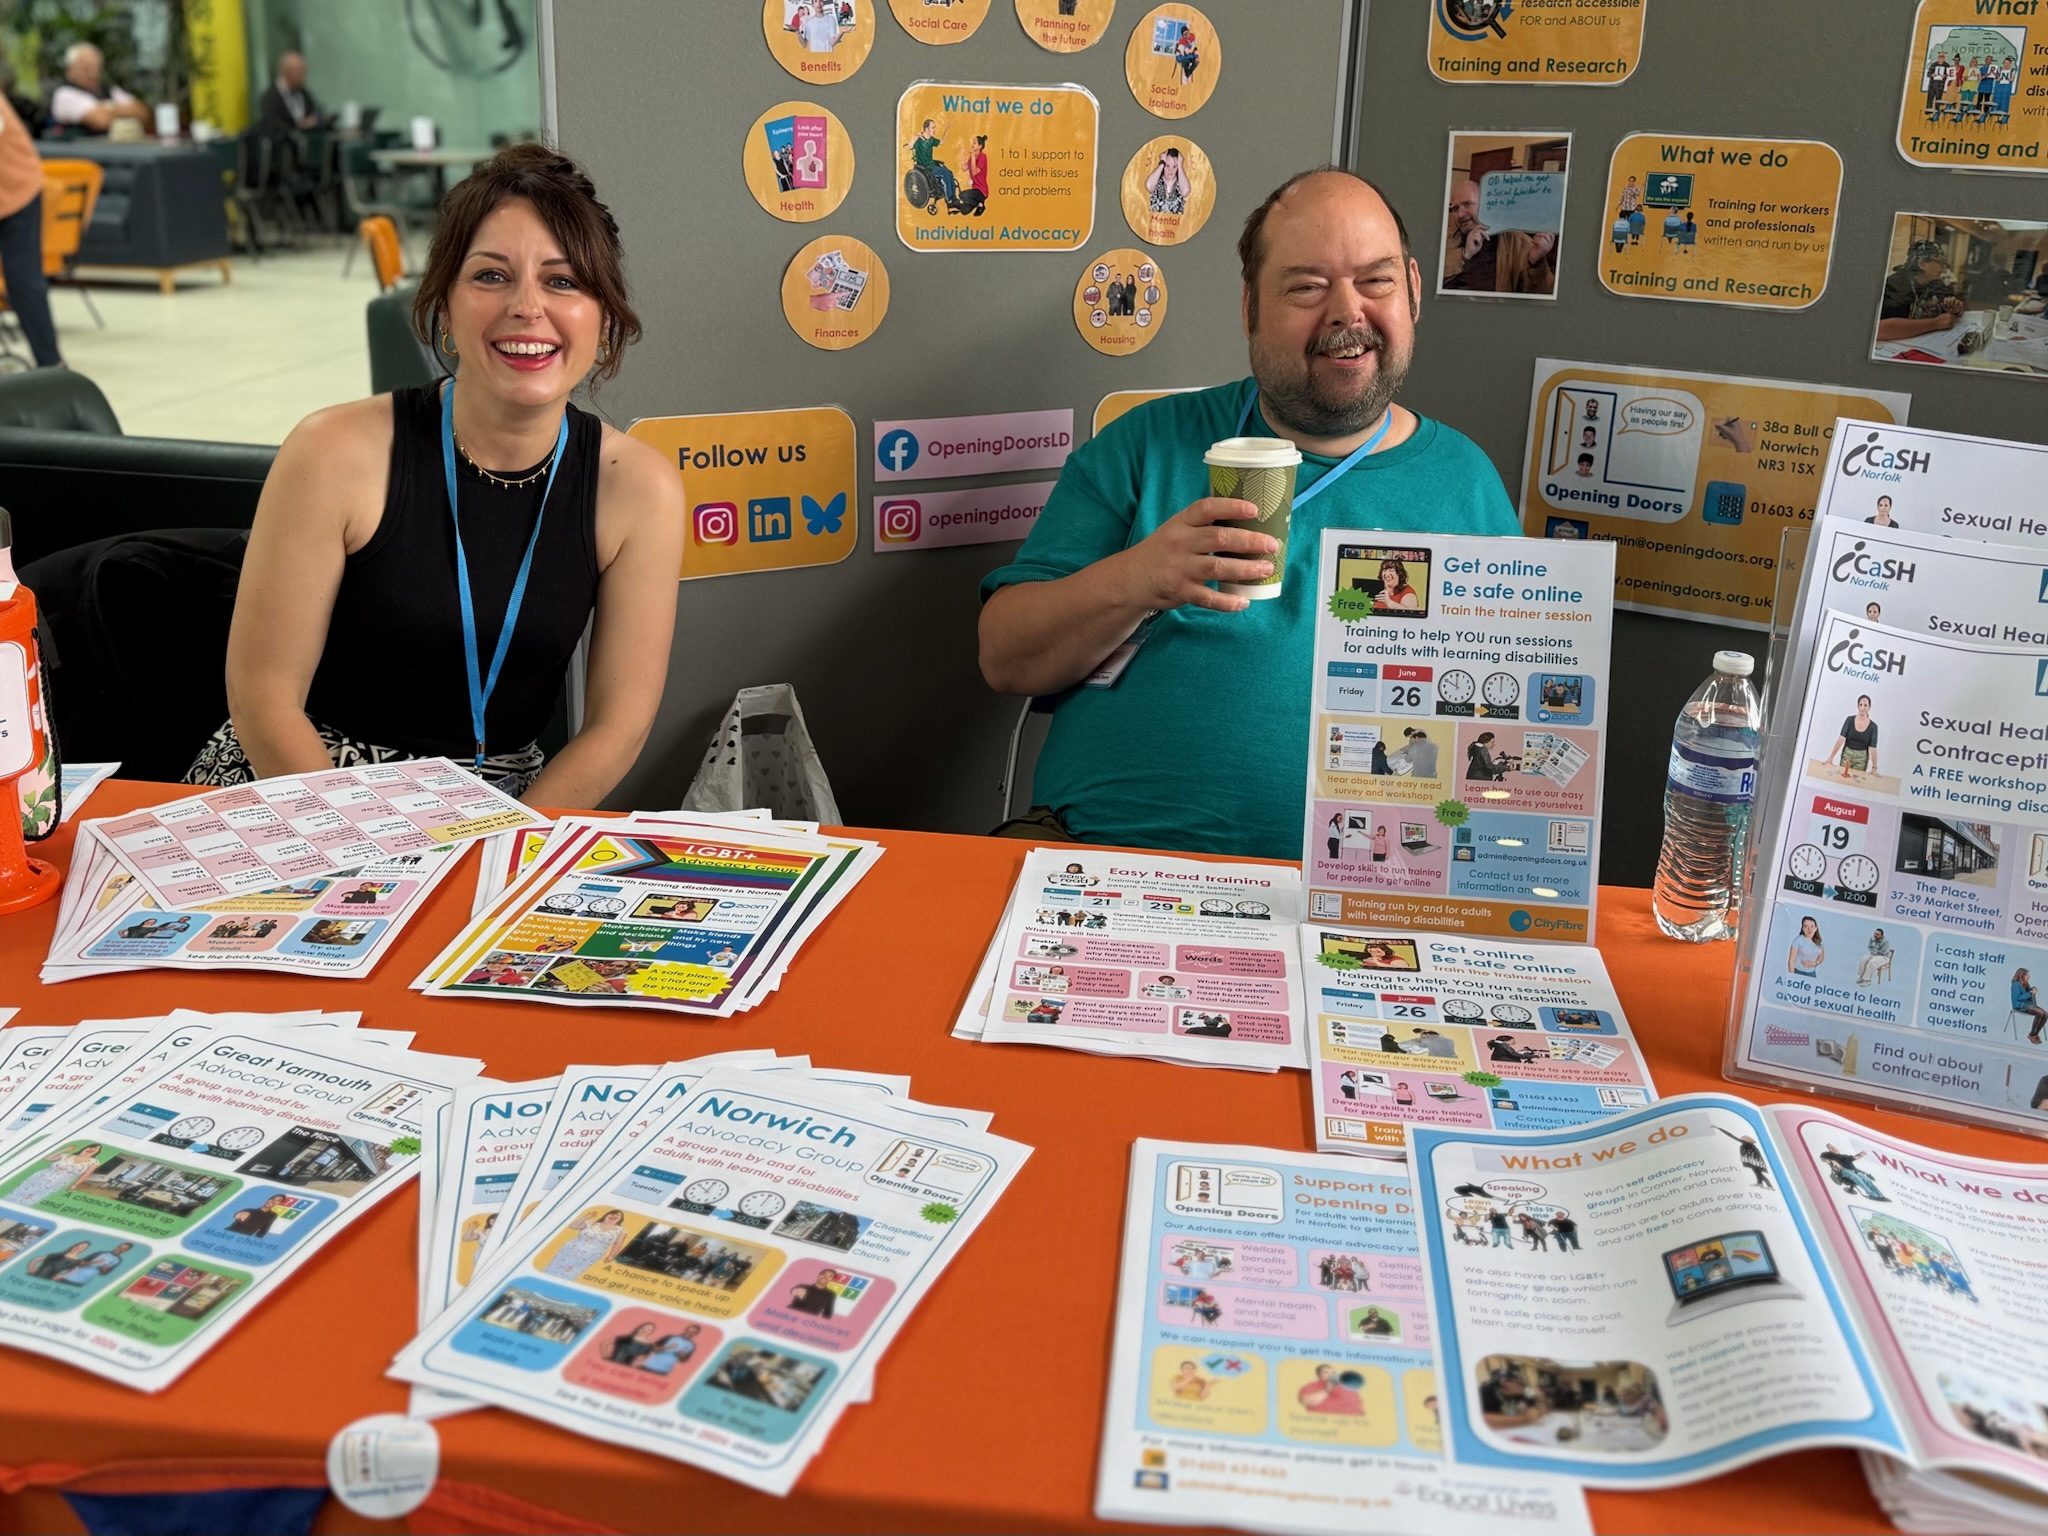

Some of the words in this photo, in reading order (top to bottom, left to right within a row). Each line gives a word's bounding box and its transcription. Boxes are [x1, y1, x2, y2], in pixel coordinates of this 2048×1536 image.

[909, 17, 939, 30] Social
[943, 20, 967, 31] Care
[1035, 17, 1074, 33] Planning
[1076, 21, 1090, 31] for
[1520, 16, 1541, 26] FOR
[1545, 16, 1566, 26] and
[1570, 16, 1606, 26] ABOUT
[1609, 18, 1620, 26] us
[1043, 33, 1056, 43] the
[1059, 34, 1087, 46] future
[1952, 46, 2006, 55] NORFOLK
[801, 61, 841, 72] Benefits
[1438, 58, 1500, 75] Training
[1508, 58, 1539, 72] and
[1546, 58, 1627, 73] Research
[1151, 85, 1178, 96] Social
[943, 95, 991, 113] What
[999, 100, 1022, 114] we
[1028, 100, 1053, 116] do
[1149, 98, 1186, 111] Isolation
[1007, 150, 1020, 160] to
[1030, 151, 1069, 163] support
[1073, 150, 1084, 160] to
[1661, 145, 1714, 164] What
[1720, 150, 1752, 166] we
[1760, 149, 1788, 167] do
[999, 167, 1020, 178] deal
[1026, 167, 1047, 178] with
[1051, 167, 1078, 178] issues
[999, 185, 1020, 195] and
[1024, 186, 1072, 198] problems
[780, 201, 814, 211] Health
[1708, 199, 1756, 213] Training
[1760, 202, 1777, 214] for
[1780, 203, 1829, 216] workers
[1150, 215, 1180, 226] Mental
[1706, 217, 1730, 229] and
[1734, 218, 1815, 234] professionals
[916, 226, 994, 241] Individual
[1000, 227, 1080, 244] Advocacy
[1149, 228, 1175, 239] health
[1704, 235, 1742, 247] written
[1746, 237, 1768, 248] and
[1772, 239, 1791, 249] run
[1795, 240, 1810, 253] by
[1813, 243, 1825, 252] us
[815, 327, 859, 338] Finances
[1101, 335, 1135, 347] Housing
[1630, 406, 1656, 417] Having
[1658, 409, 1672, 418] our
[1674, 411, 1687, 420] say
[1631, 417, 1639, 425] as
[1642, 417, 1667, 427] people
[1669, 419, 1684, 428] first
[1763, 422, 1789, 434] 38a
[1794, 424, 1818, 437] Bull
[928, 432, 1070, 459] OpeningDoorsLD
[1761, 440, 1819, 457] Norwich
[679, 445, 768, 471] Follow
[778, 445, 806, 463] us
[1758, 459, 1786, 473] NR3
[1791, 462, 1815, 476] 1SX
[1861, 470, 1902, 483] Norfolk
[1545, 484, 1619, 508] Opening
[1626, 493, 1683, 514] Doors
[1751, 502, 1793, 518] 01603
[1942, 508, 2012, 531] Sexual
[1444, 557, 1480, 574] Get
[1487, 560, 1547, 577] online
[1443, 581, 1466, 597] Be
[1473, 583, 1515, 599] safe
[1522, 586, 1582, 603] online
[1338, 600, 1364, 610] Free
[1441, 605, 1470, 616] Train
[1474, 606, 1494, 617] the
[1500, 608, 1540, 619] trainer
[1545, 610, 1592, 622] session
[1345, 626, 1398, 640] Training
[1403, 628, 1416, 639] to
[1420, 629, 1450, 643] help
[1456, 631, 1485, 643] YOU
[1489, 634, 1511, 645] run
[1516, 634, 1572, 648] sessions
[1344, 642, 1361, 653] for
[1366, 643, 1406, 656] adults
[1412, 646, 1438, 658] with
[1443, 648, 1500, 663] learning
[1506, 651, 1578, 665] disabilities
[1398, 668, 1416, 678] June
[1339, 687, 1364, 697] Friday
[1391, 686, 1421, 707] 26
[1551, 713, 1579, 721] zoom
[1920, 711, 1992, 736] Sexual
[1913, 764, 1924, 776] A
[1929, 766, 1963, 782] FREE
[1968, 772, 2047, 794] workshop
[1910, 784, 1940, 799] with
[1945, 788, 2012, 812] learning
[1824, 802, 1856, 817] August
[1822, 824, 1849, 850] 19
[685, 845, 757, 859] LGBT+
[676, 858, 752, 869] Advocacy
[755, 864, 800, 875] Group
[1109, 868, 1149, 878] Easy
[1154, 871, 1199, 882] Read
[1205, 875, 1271, 887] training
[1469, 870, 1510, 881] Contact
[1513, 873, 1524, 881] us
[1526, 873, 1539, 882] for
[1543, 875, 1569, 885] more
[1916, 882, 1937, 894] The
[1942, 885, 1979, 901] Place,
[1093, 898, 1111, 906] 21
[1150, 902, 1173, 911] 29
[1891, 891, 1921, 905] 37-39
[1925, 896, 1963, 913] Market
[1967, 901, 2003, 918] Street,
[1534, 918, 1584, 931] CityFibre
[1895, 906, 1930, 920] Great
[1933, 909, 1995, 930] Yarmouth
[1185, 955, 1223, 964] Words
[1936, 944, 1975, 960] i-cash
[1979, 950, 2005, 964] staff
[1935, 960, 1960, 971] can
[1963, 961, 1986, 976] talk
[1932, 973, 1958, 987] with
[1961, 976, 1985, 991] you
[1775, 977, 1785, 986] A
[1786, 977, 1811, 993] safe
[1815, 983, 1850, 1002] place
[1854, 990, 1866, 1002] to
[1869, 994, 1900, 1009] learn
[1776, 990, 1810, 1006] about
[1814, 997, 1853, 1013] sexual
[1857, 1005, 1895, 1022] health
[1874, 1043, 1904, 1060] Find
[1909, 1048, 1933, 1064] out
[1937, 1054, 1983, 1074] about
[213, 1045, 276, 1068] Great
[278, 1060, 373, 1092] Yarmouth
[1872, 1060, 1980, 1090] contraception
[191, 1058, 292, 1090] Advocacy
[293, 1083, 354, 1106] Group
[697, 1097, 856, 1148] Norwich
[677, 1120, 791, 1153] Advocacy
[796, 1146, 864, 1173] Group
[1501, 1154, 1583, 1170] What
[1592, 1140, 1637, 1163] we
[1648, 1124, 1689, 1145] do
[870, 1174, 919, 1195] Opening
[922, 1187, 959, 1204] Doors
[1294, 1175, 1374, 1195] Support
[1294, 1193, 1387, 1216] Opening
